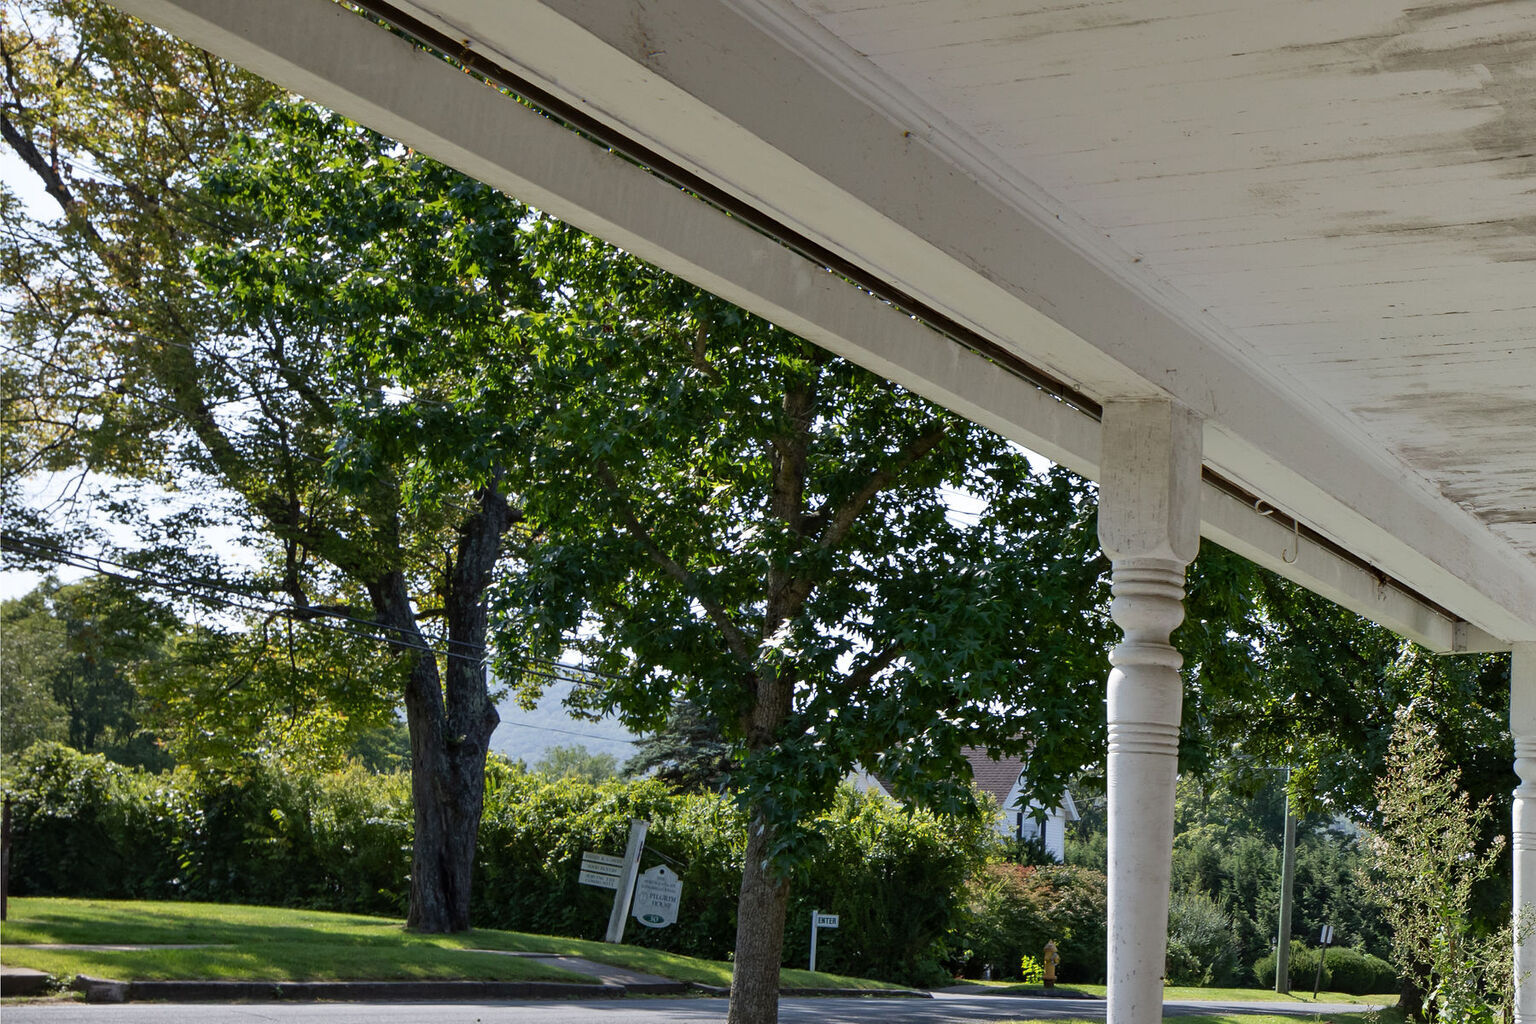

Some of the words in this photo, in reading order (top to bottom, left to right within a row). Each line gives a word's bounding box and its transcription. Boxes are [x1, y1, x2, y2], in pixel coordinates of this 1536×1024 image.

[649, 893, 676, 903] PILGRIM
[651, 900, 671, 908] HOUSE
[818, 916, 836, 924] ENTER
